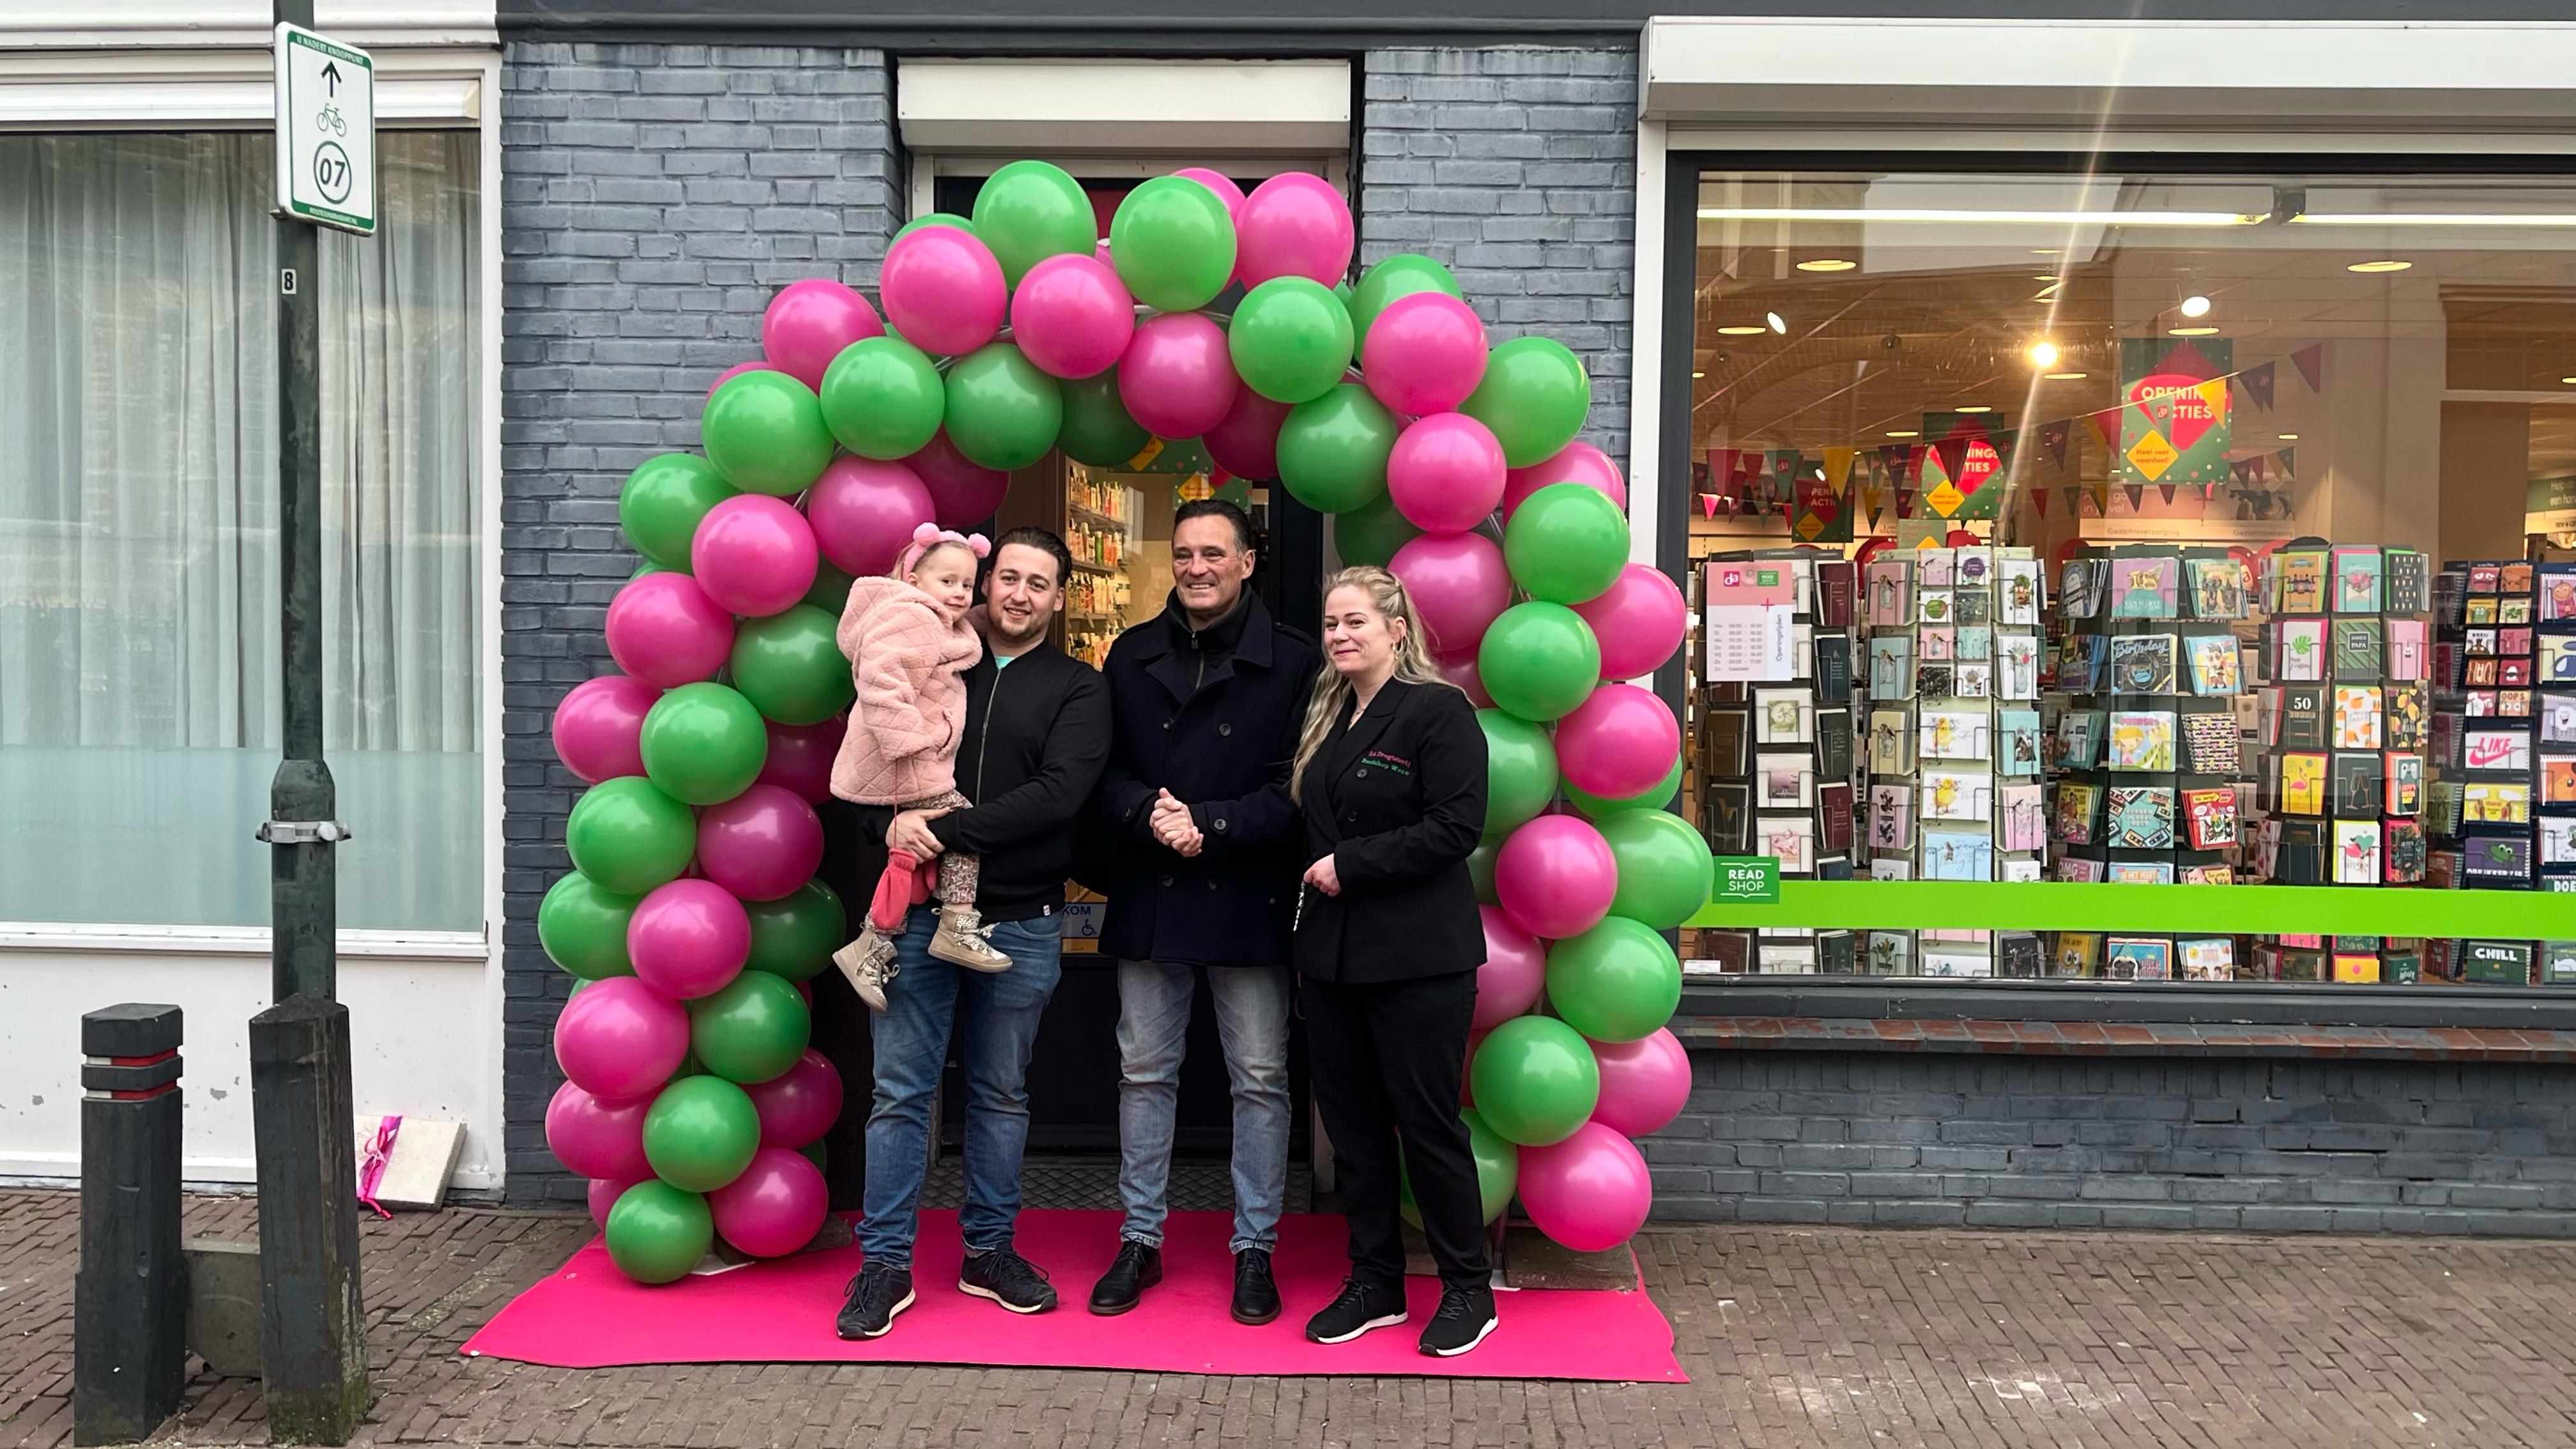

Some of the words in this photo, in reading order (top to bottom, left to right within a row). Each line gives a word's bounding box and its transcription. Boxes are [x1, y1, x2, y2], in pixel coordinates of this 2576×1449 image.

[296, 34, 302, 44] U
[303, 37, 327, 54] NADERT
[328, 45, 364, 65] KNOOPPUNT
[320, 158, 346, 187] 07
[284, 271, 294, 291] 8
[2172, 405, 2213, 419] CTIES
[1964, 461, 1991, 472] TIES
[2233, 530, 2295, 538] Gezichtsverzorg
[1725, 573, 1739, 585] da
[2113, 639, 2170, 659] Birthday
[2501, 692, 2525, 701] OOPS
[2294, 697, 2312, 710] 50
[2477, 737, 2511, 754] LIKE
[1728, 869, 1765, 880] READ
[2058, 862, 2078, 876] OMG
[1728, 880, 1765, 891] SHOP
[1062, 905, 1091, 916] KOM
[2474, 947, 2518, 962] CHILL
